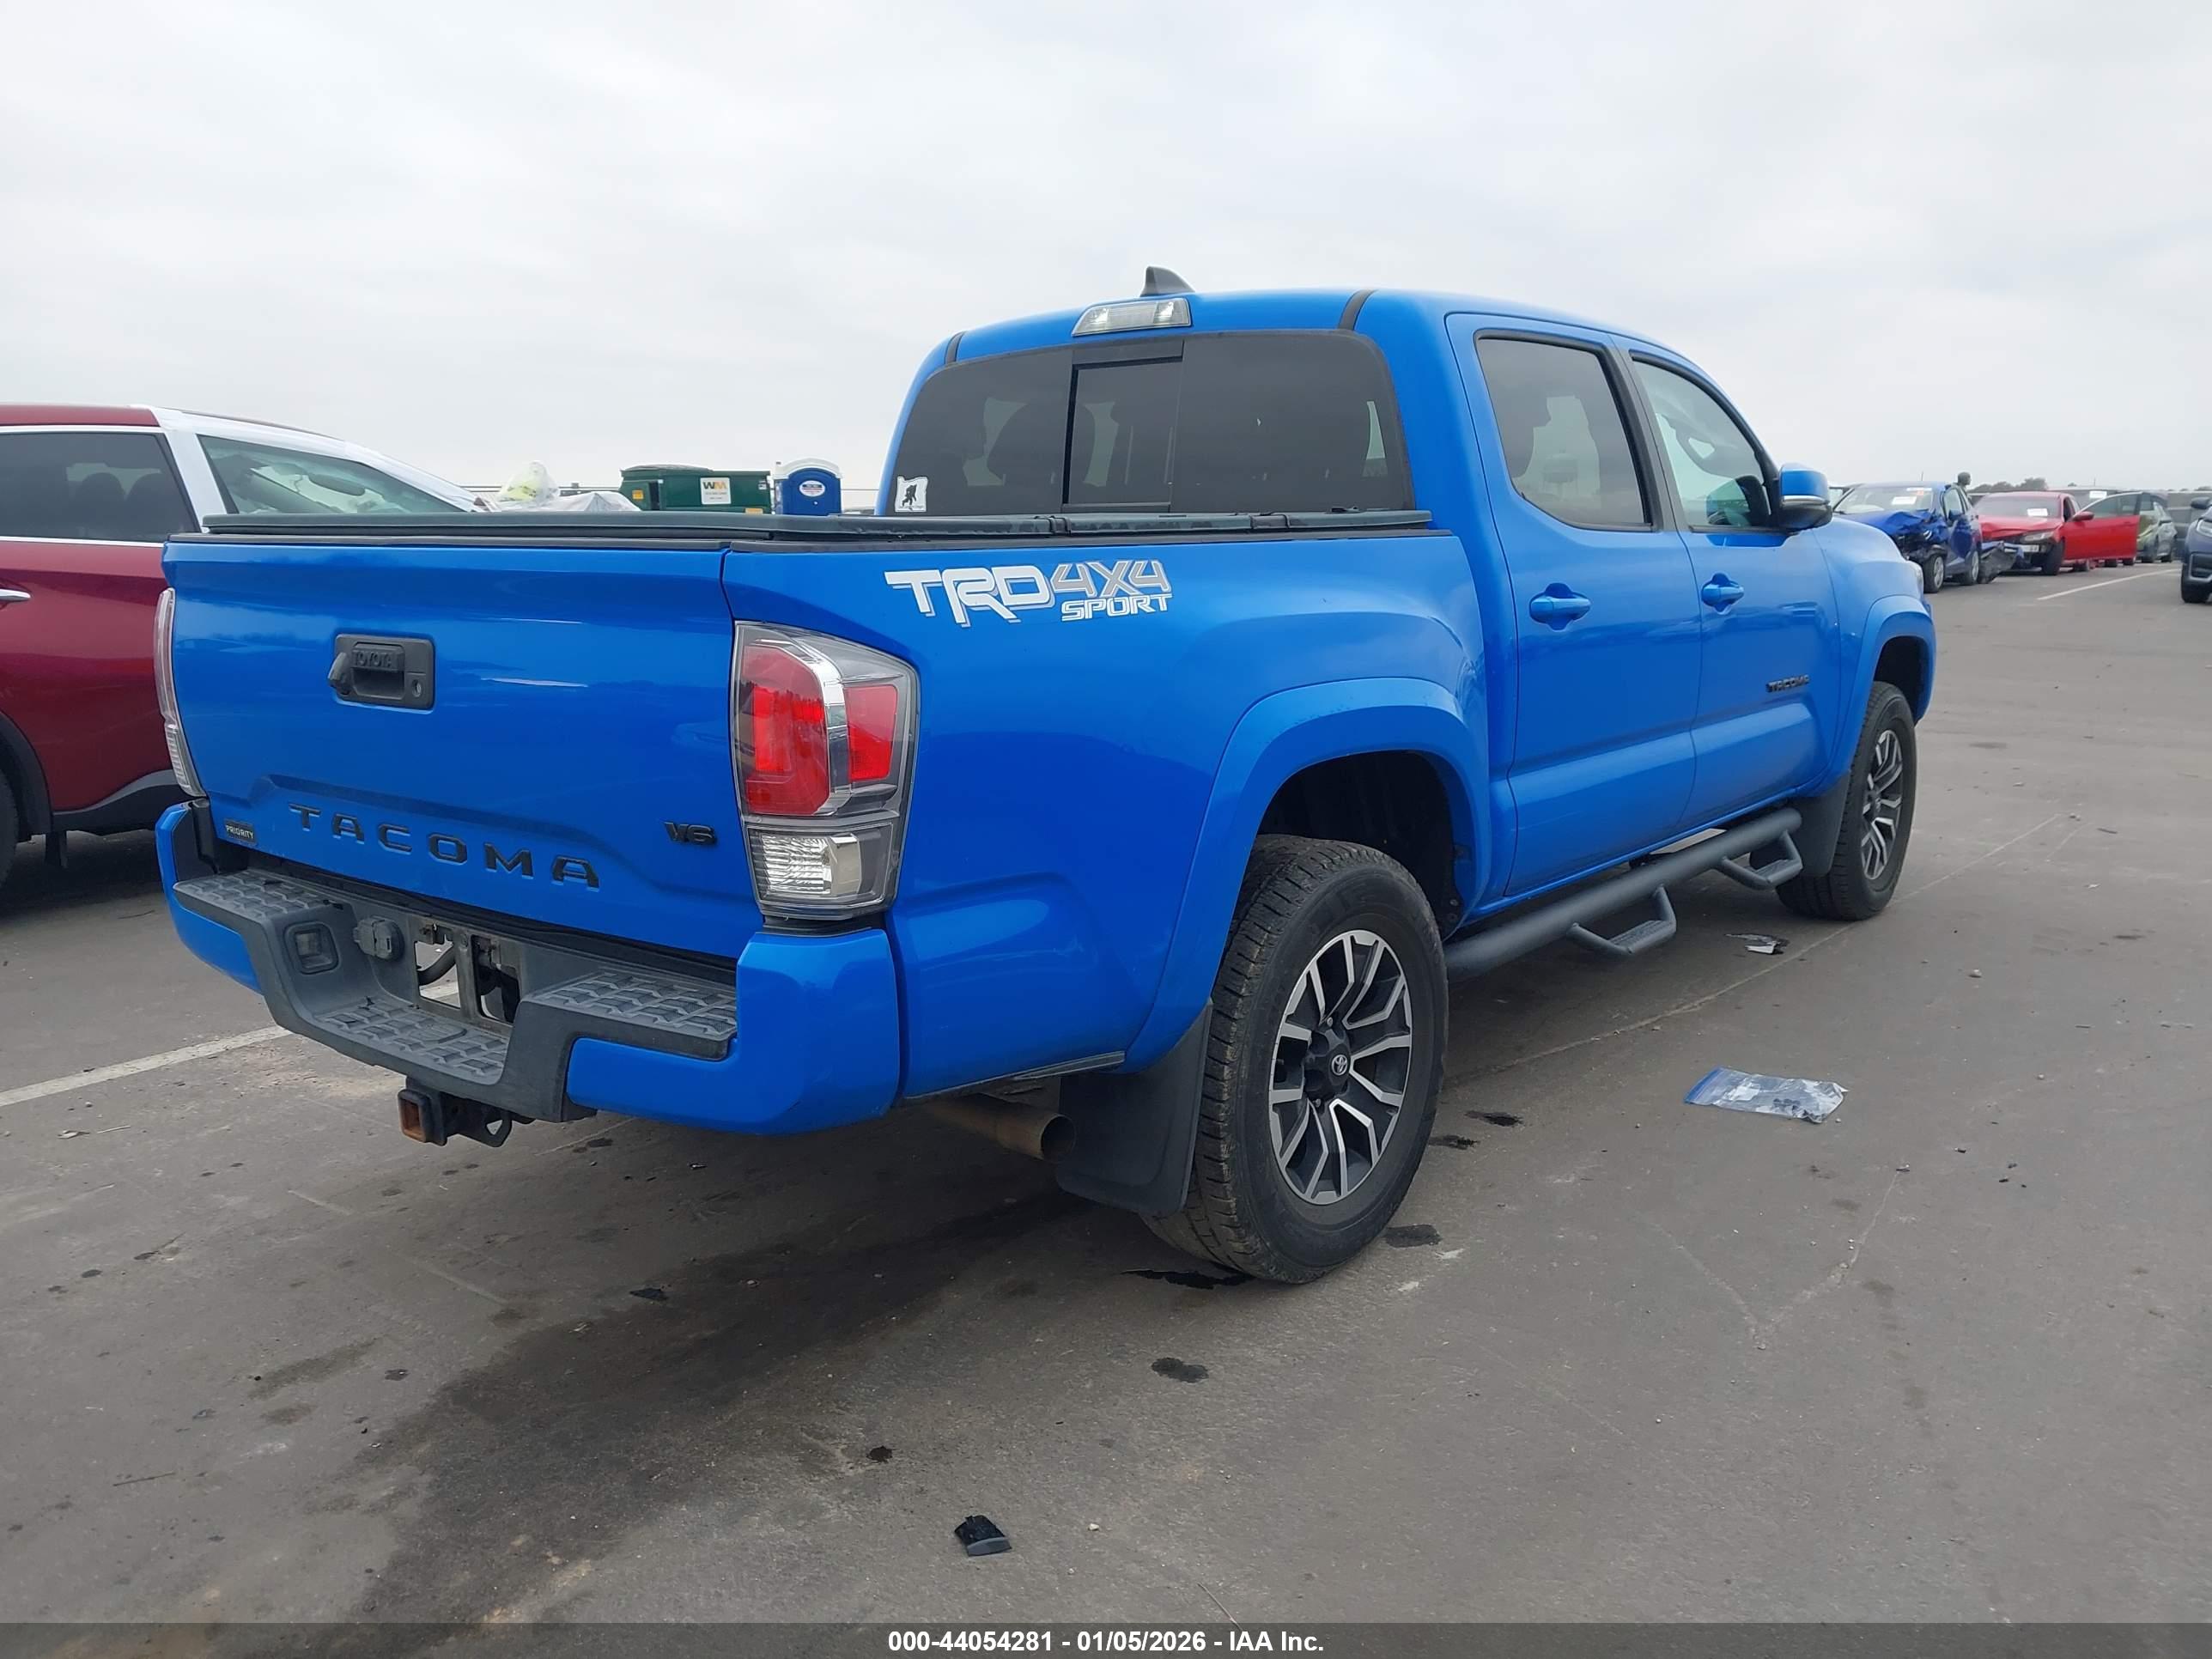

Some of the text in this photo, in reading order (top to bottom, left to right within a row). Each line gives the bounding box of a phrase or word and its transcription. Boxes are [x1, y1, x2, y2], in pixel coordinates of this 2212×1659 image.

[702, 481, 727, 490] WM
[884, 558, 1173, 628] TRD 4X4
[1060, 592, 1173, 622] SPORT
[353, 650, 393, 668] TOYOTA
[225, 824, 254, 839] PRIORITY
[664, 821, 715, 844] V6
[289, 803, 600, 890] TACOMA
